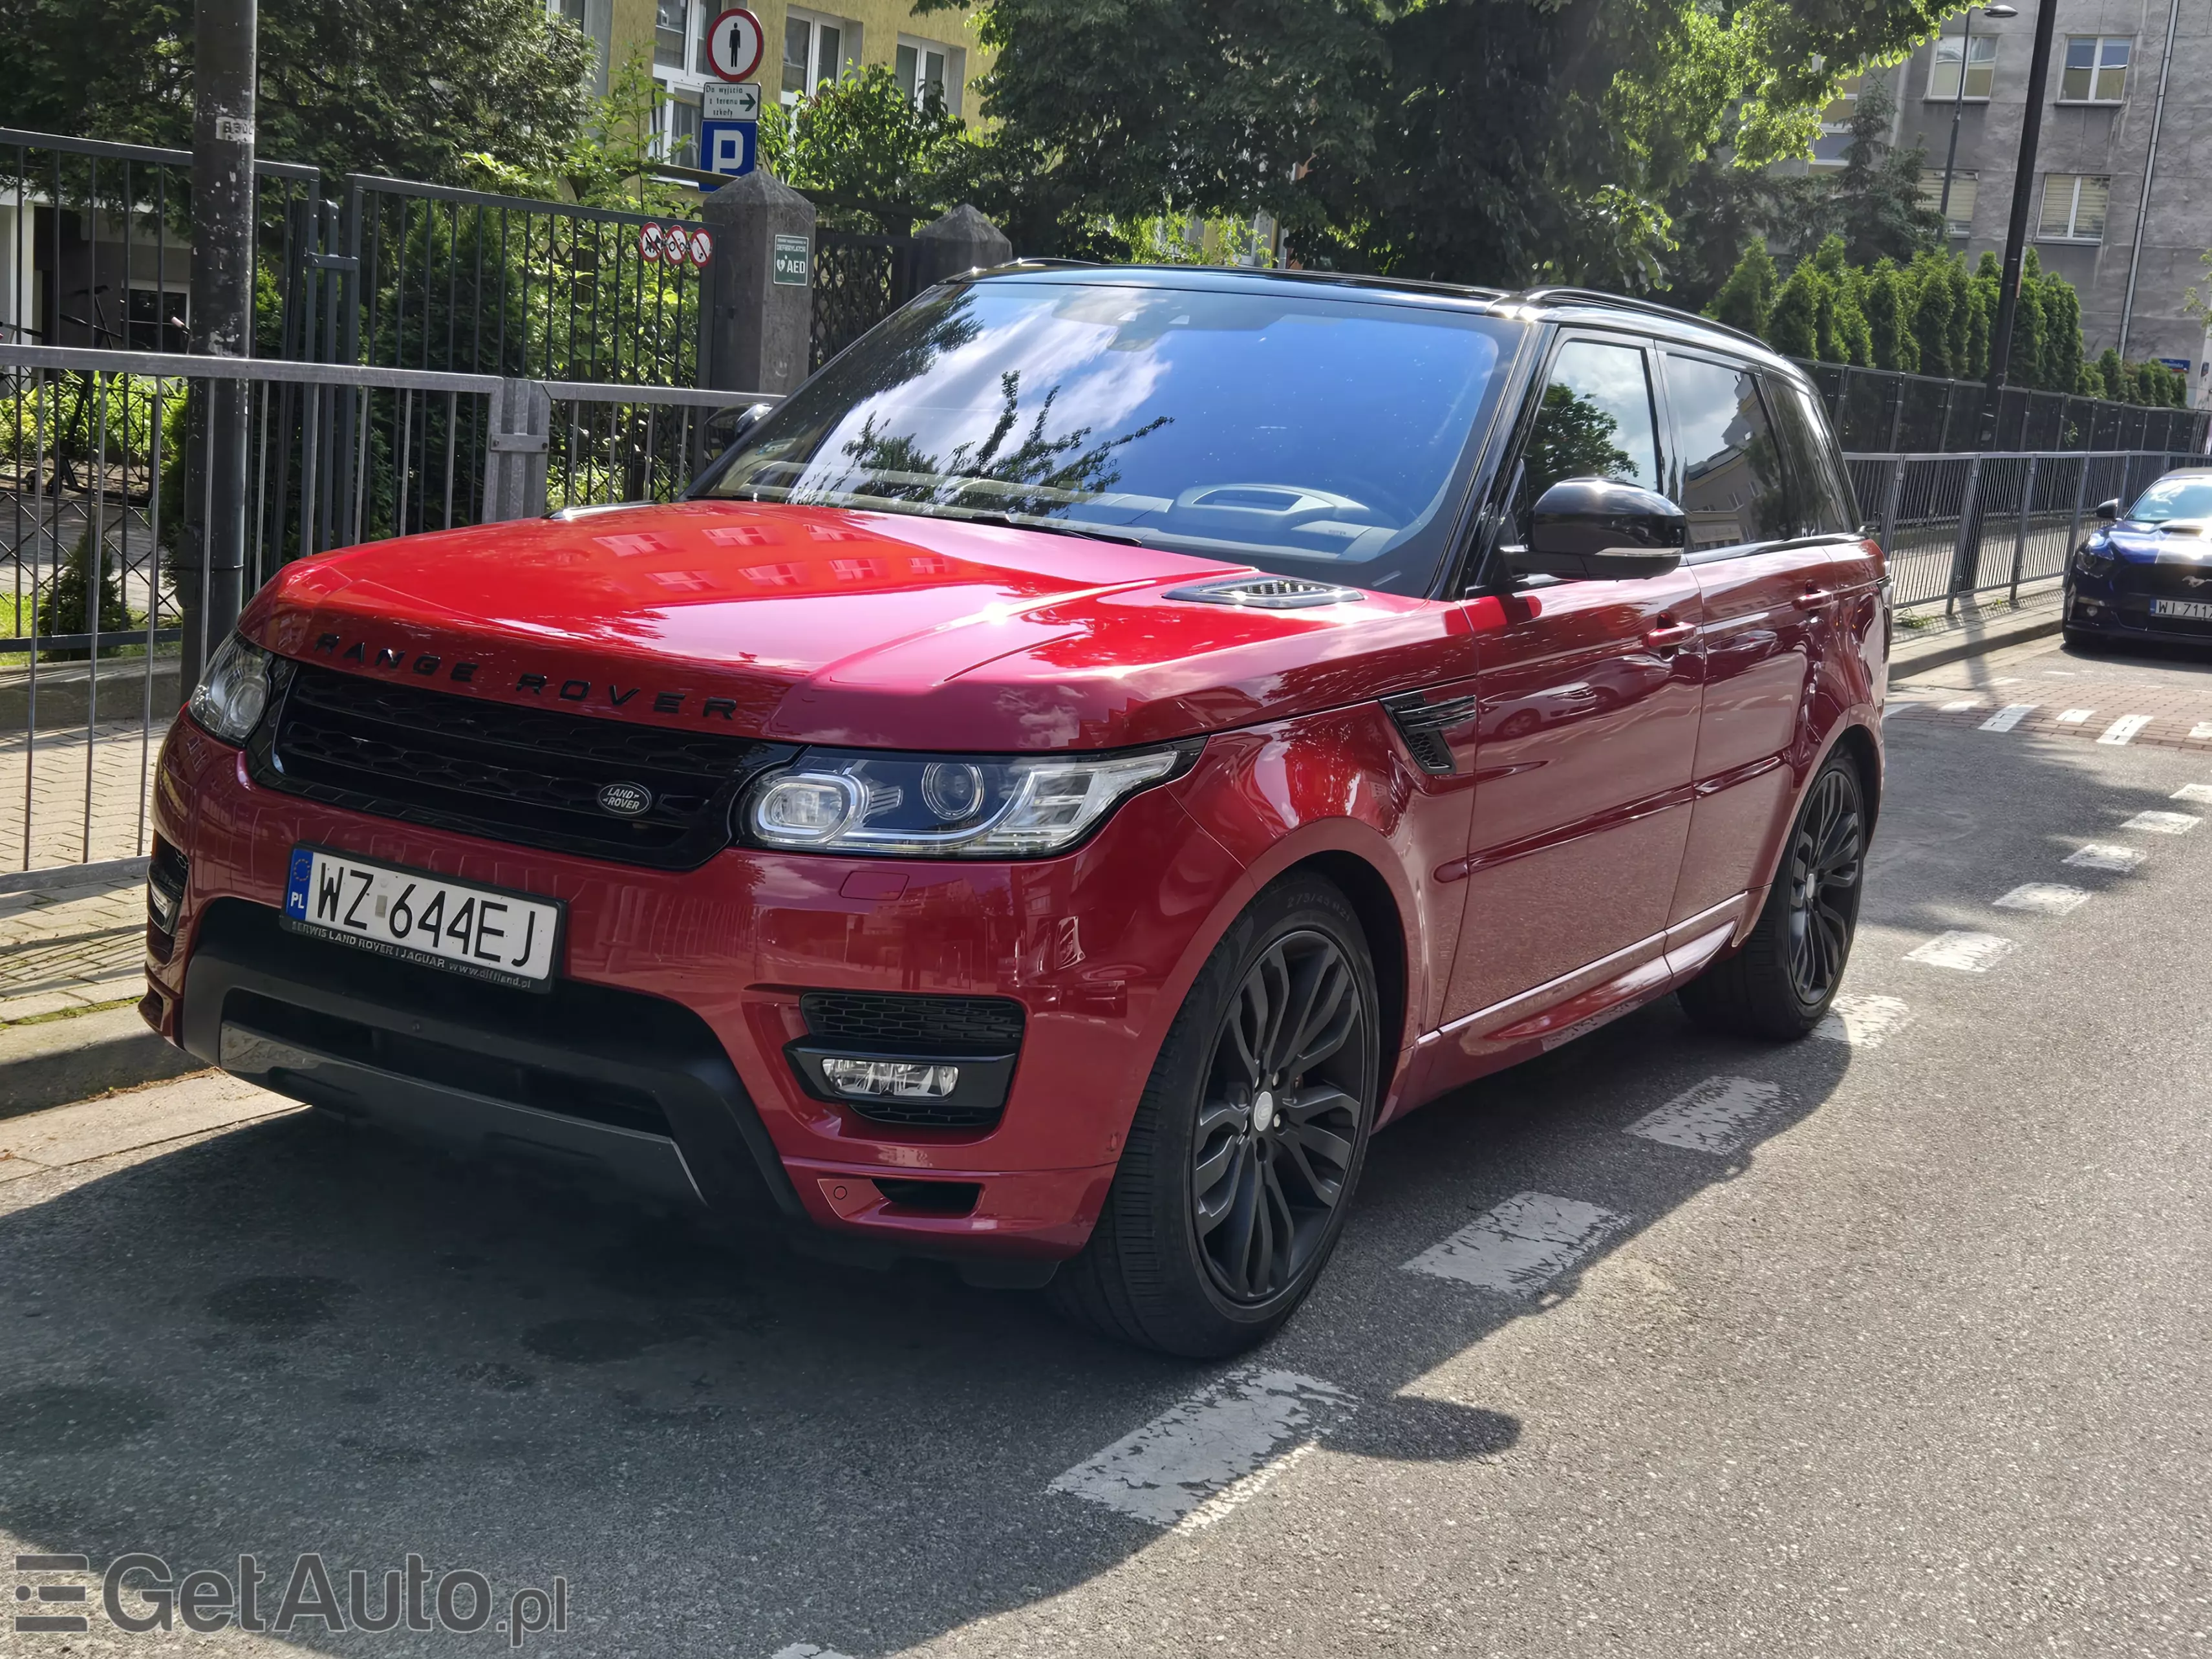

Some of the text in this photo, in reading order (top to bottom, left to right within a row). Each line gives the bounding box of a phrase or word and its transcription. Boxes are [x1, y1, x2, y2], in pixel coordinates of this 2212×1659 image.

[712, 129, 744, 173] P
[787, 260, 806, 273] AED
[2158, 601, 2175, 614] WI
[314, 632, 738, 720] RANGE ROVER
[608, 787, 634, 798] LAND
[608, 797, 639, 809] ROVER
[290, 892, 305, 909] PL
[317, 862, 536, 967] WZ 644EJ
[292, 921, 327, 937] SERWIS
[329, 931, 356, 945] LAND
[358, 938, 394, 955] ROVER
[401, 948, 446, 968] JAGUAR
